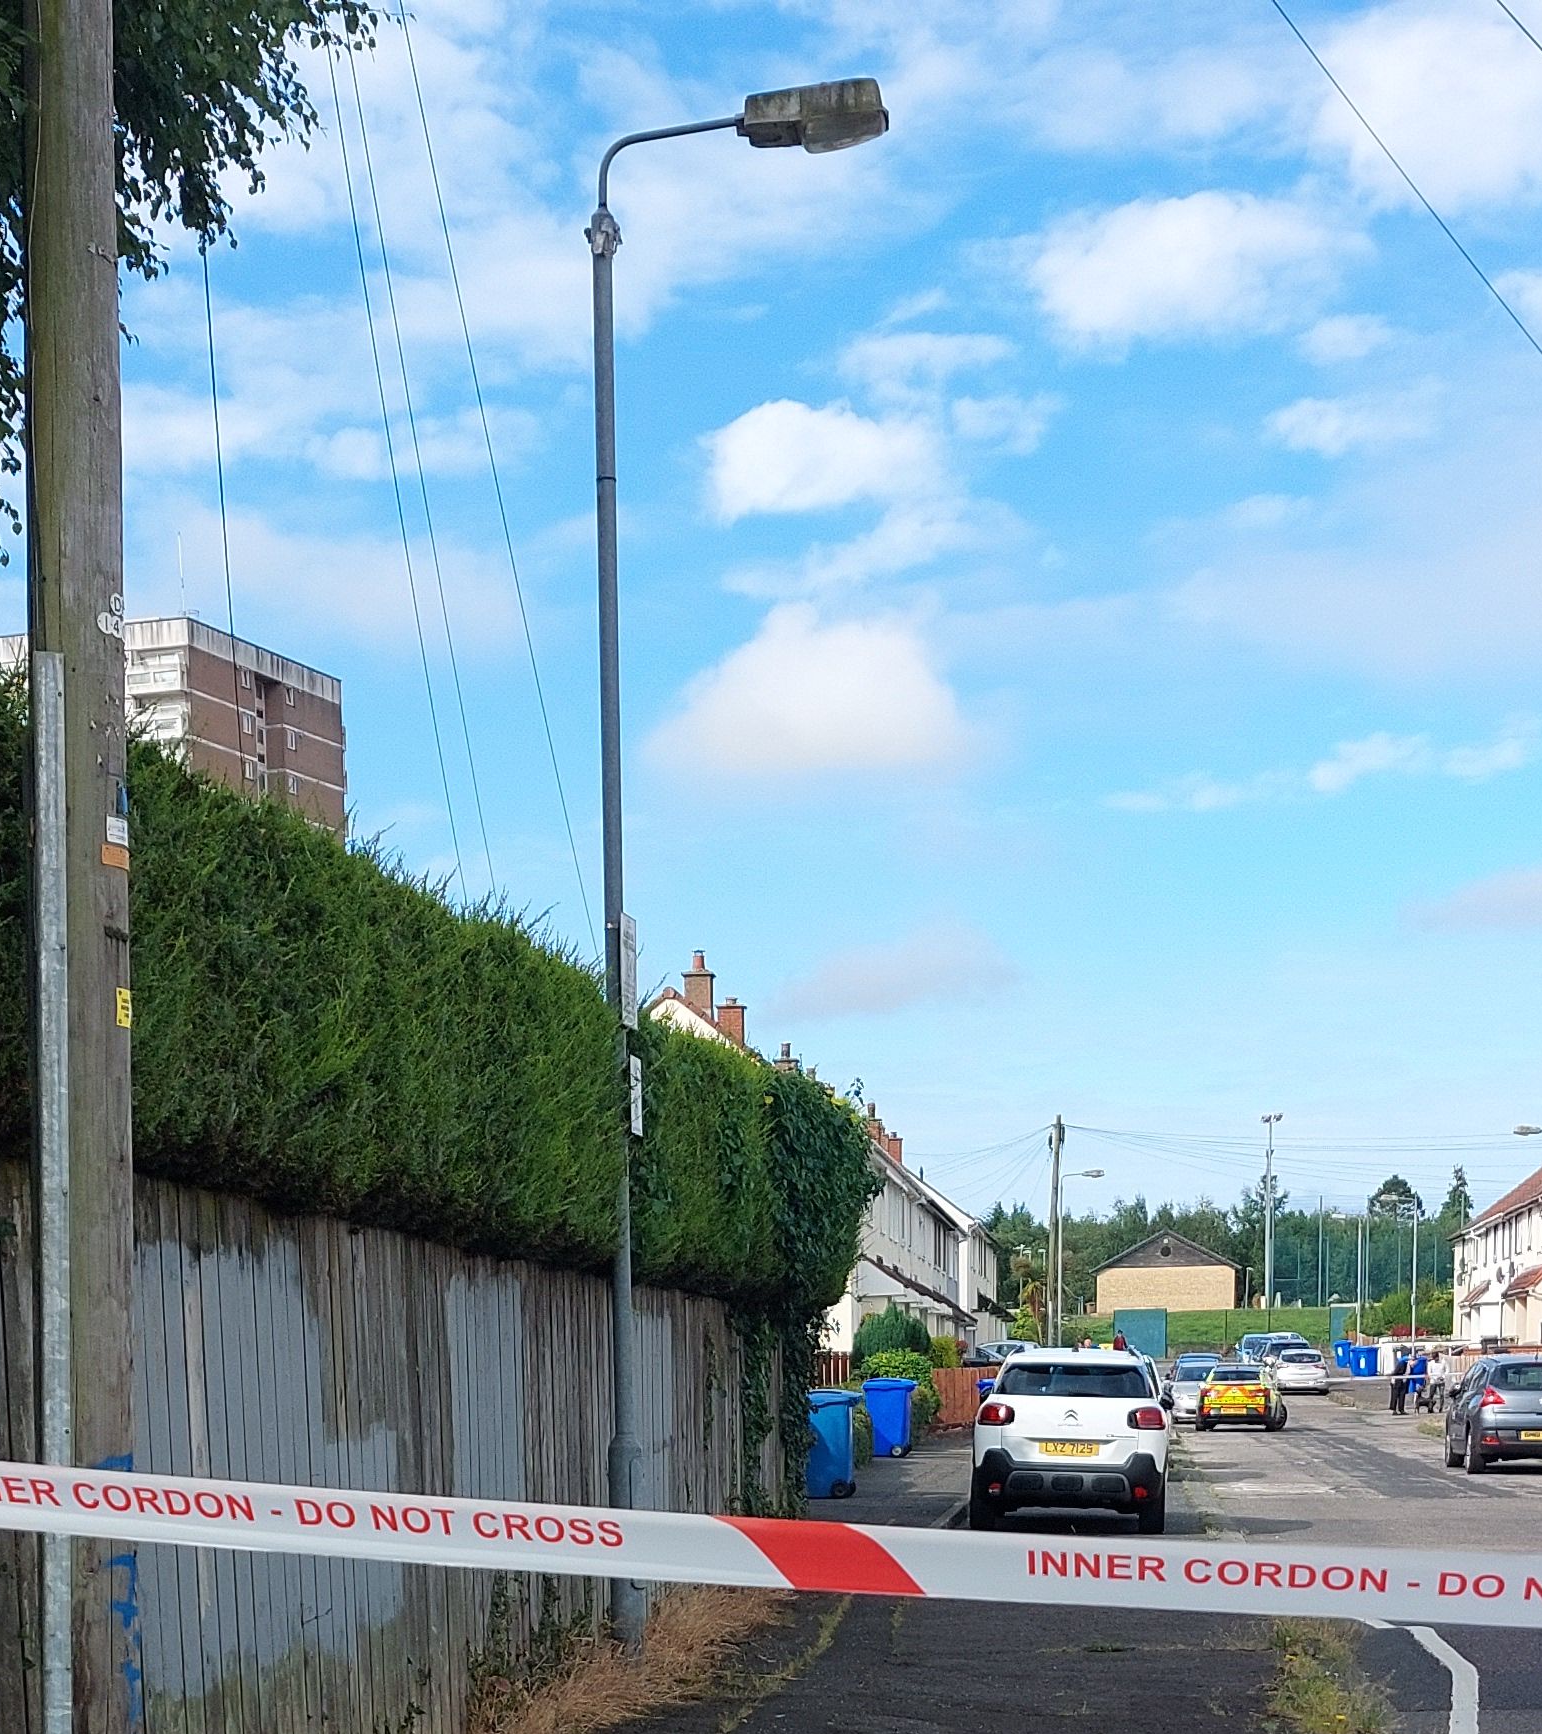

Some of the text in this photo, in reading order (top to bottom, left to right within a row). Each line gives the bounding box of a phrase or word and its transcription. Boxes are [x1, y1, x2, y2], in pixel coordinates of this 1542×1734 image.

[71, 1481, 255, 1522] CORDON
[295, 1498, 357, 1529] DO
[370, 1503, 453, 1537] NOT
[471, 1511, 624, 1549] CROSS
[1027, 1550, 1166, 1583] INNER
[1183, 1558, 1388, 1594] CORDON
[1437, 1570, 1507, 1599] DO
